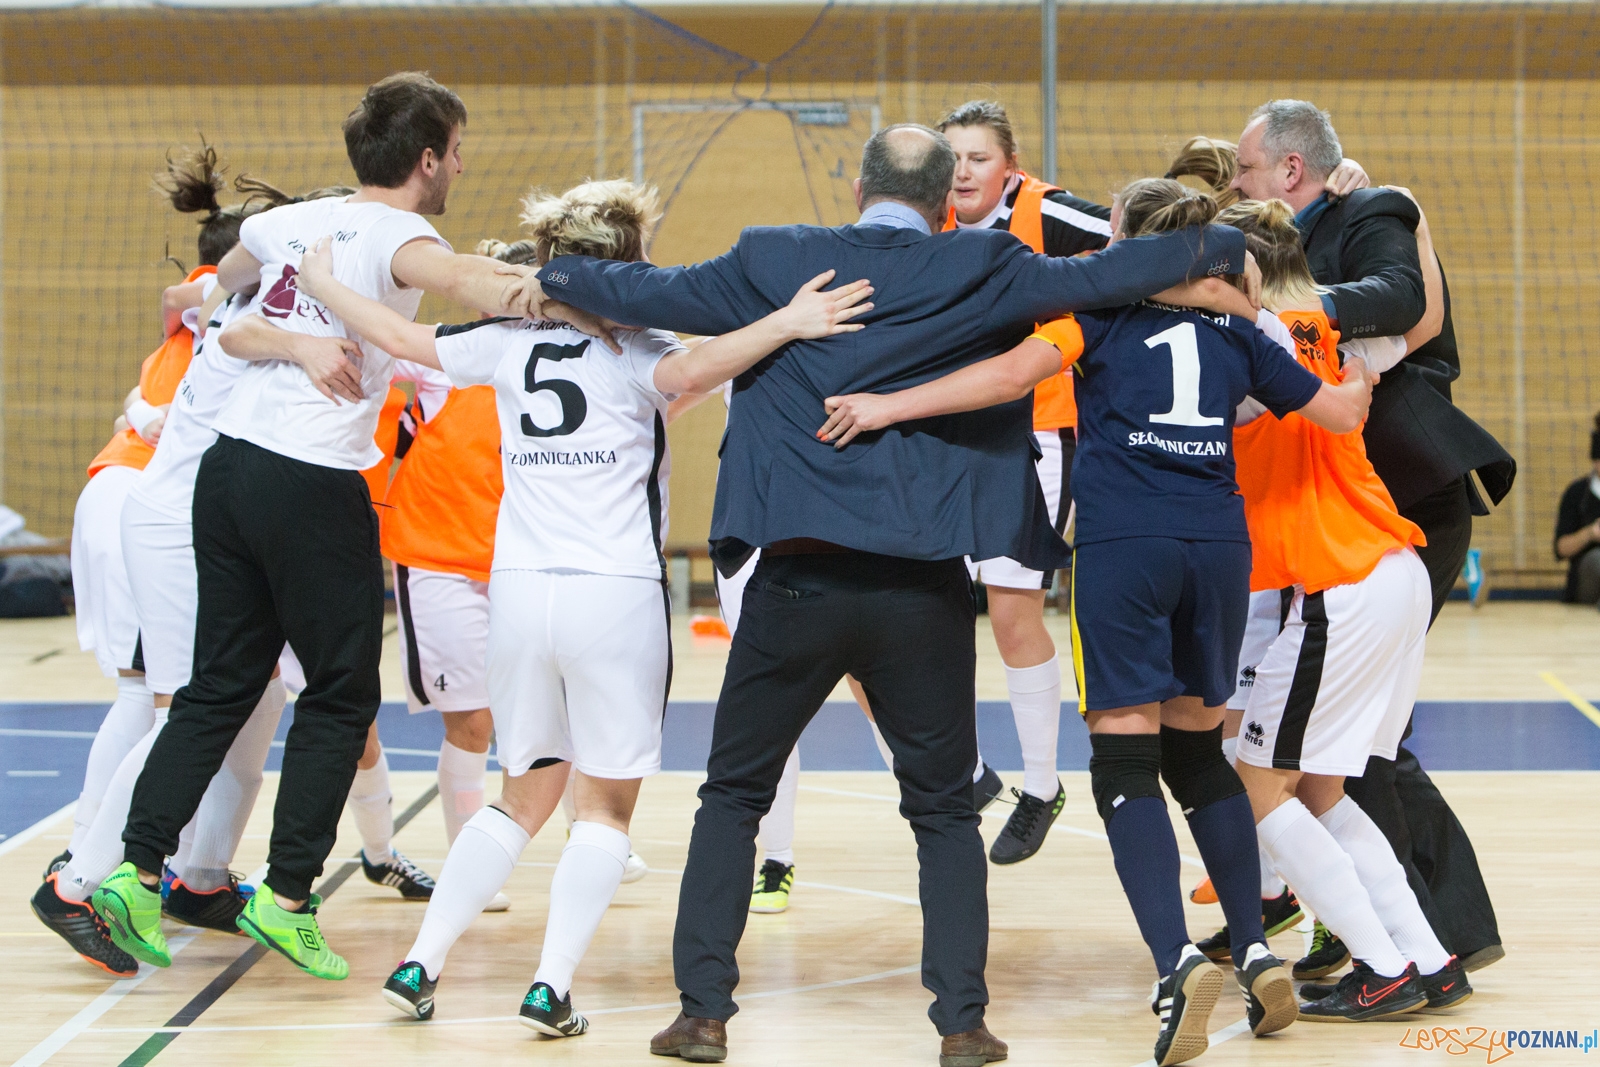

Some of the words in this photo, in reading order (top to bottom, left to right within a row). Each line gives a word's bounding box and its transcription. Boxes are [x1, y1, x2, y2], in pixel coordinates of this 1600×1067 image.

[1143, 321, 1224, 427] 1
[520, 339, 591, 438] 5
[433, 673, 448, 692] 4
[393, 973, 421, 993] adidas
[523, 997, 552, 1013] adidas
